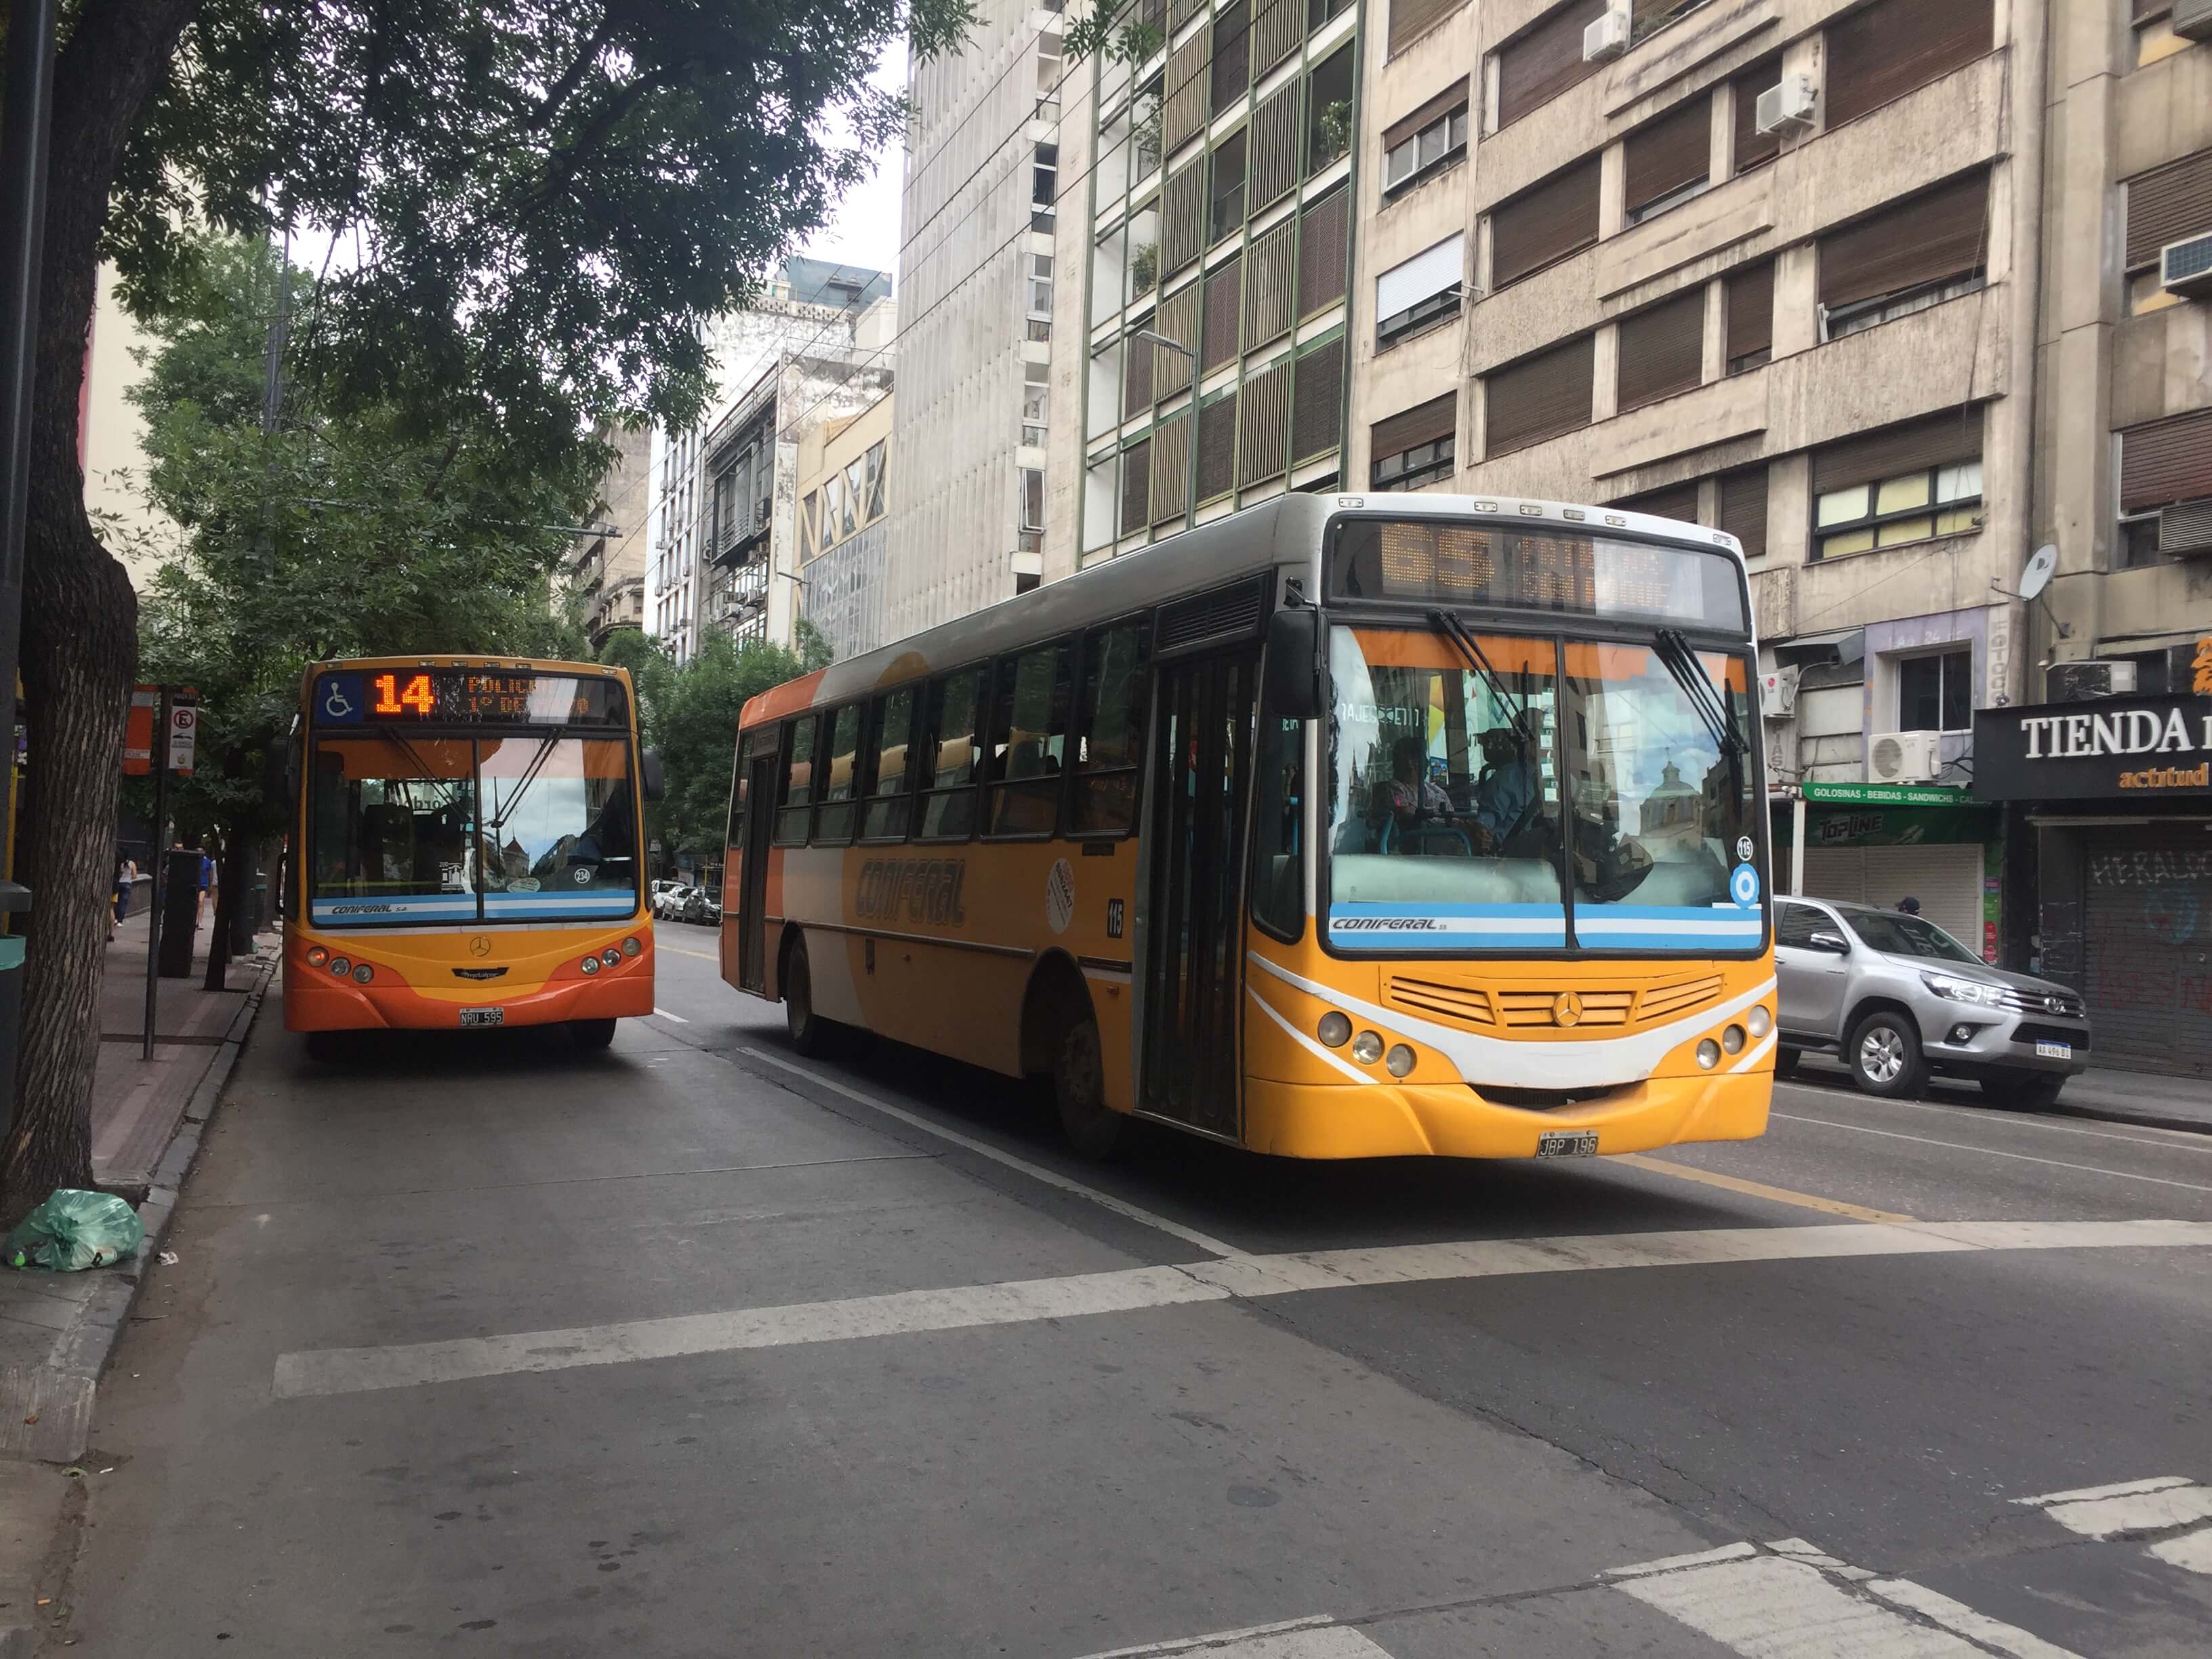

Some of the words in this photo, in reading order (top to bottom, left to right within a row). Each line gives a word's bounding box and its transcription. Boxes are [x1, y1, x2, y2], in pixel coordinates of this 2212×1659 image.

[1381, 523, 1495, 588] 65
[375, 674, 434, 712] 14
[2021, 708, 2195, 758] TIENDA
[2119, 762, 2209, 788] actitud
[1814, 787, 1862, 799] GOLOSINAS
[1867, 790, 1902, 801] BEBIDAS
[1908, 792, 1953, 804] SANDWICHS
[1739, 840, 1751, 856] 115
[577, 872, 588, 881] 234
[856, 858, 966, 928] CONIFERAL
[332, 905, 392, 914] CONIFERAL
[1109, 903, 1124, 935] 115
[1333, 919, 1437, 930] CONIFERAL
[461, 1012, 479, 1025] NRU
[484, 1012, 502, 1023] 595
[1540, 1140, 1565, 1155] JBP
[1572, 1138, 1597, 1154] 196
